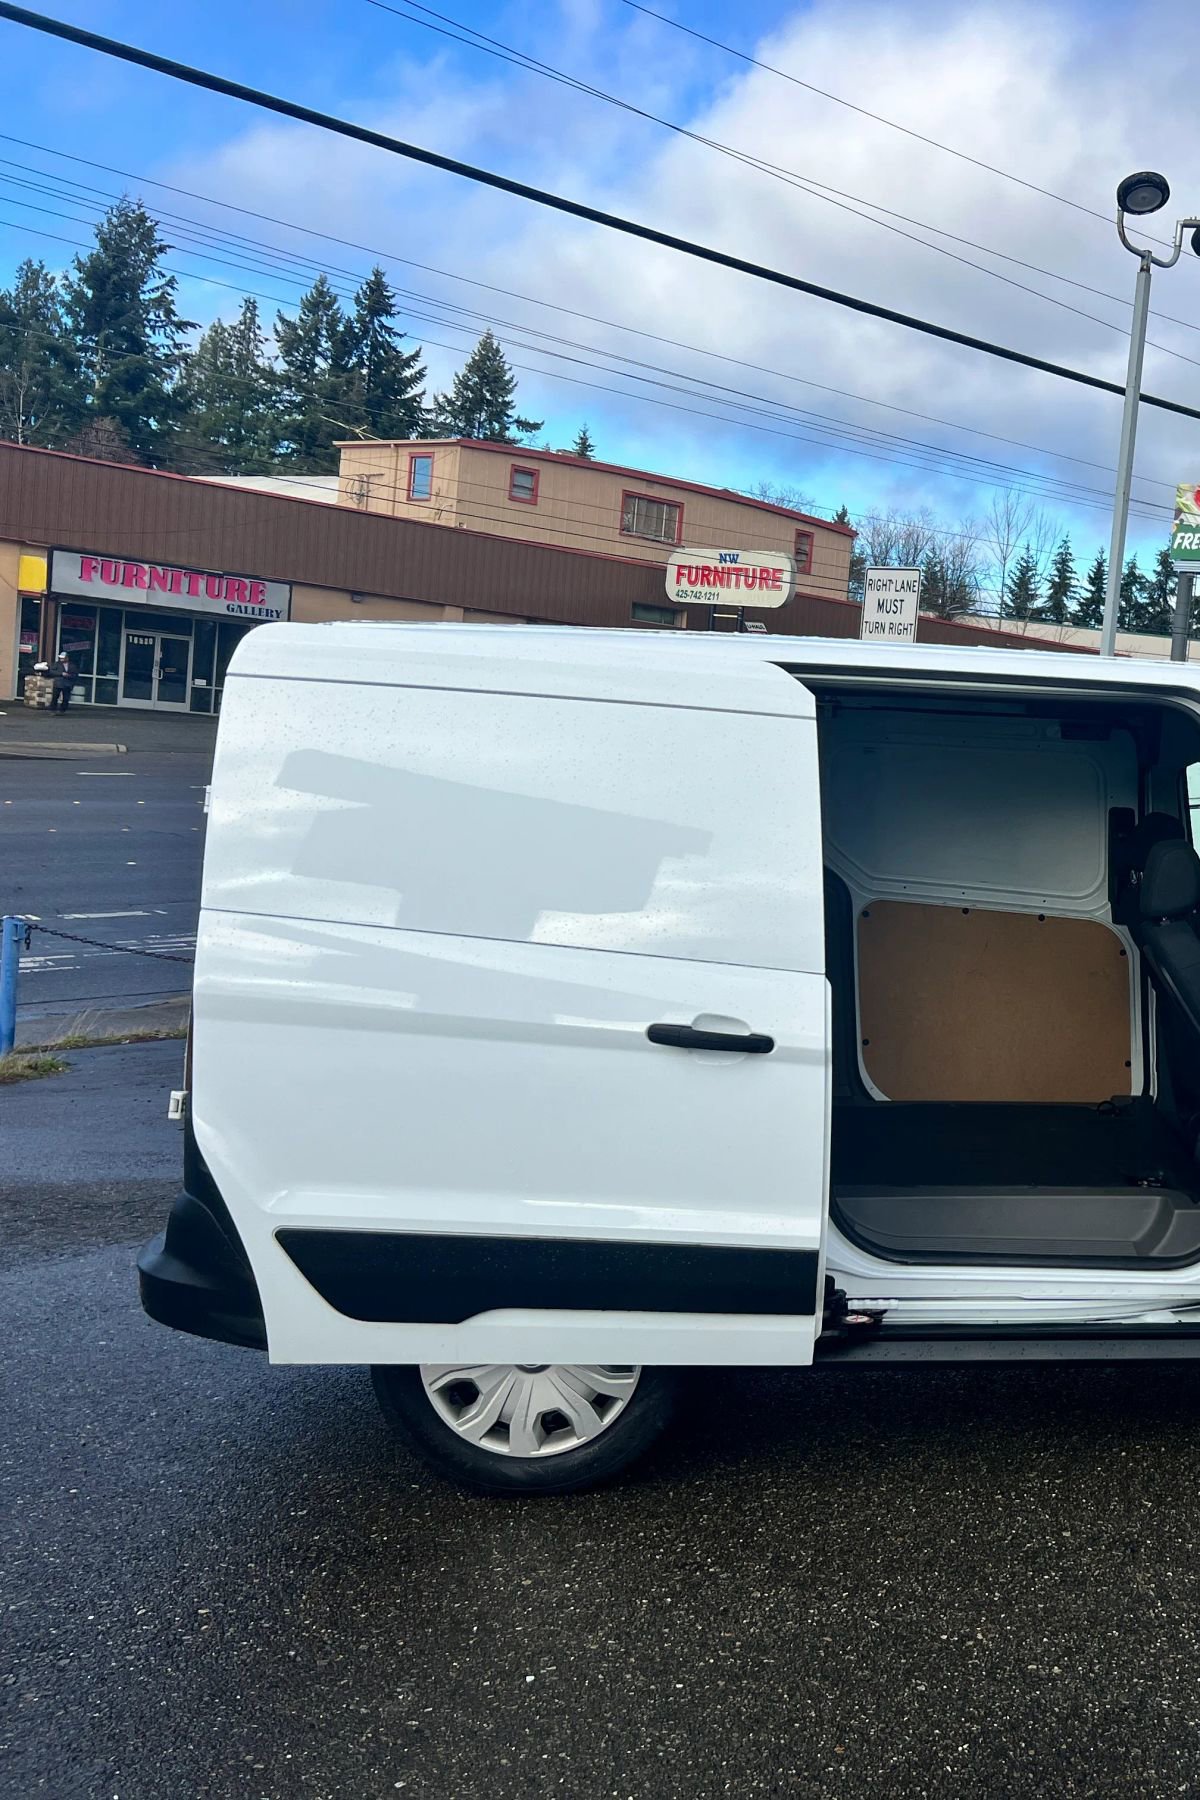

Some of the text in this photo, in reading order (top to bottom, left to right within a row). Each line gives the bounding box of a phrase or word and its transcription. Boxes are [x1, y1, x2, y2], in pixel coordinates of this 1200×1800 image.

[719, 552, 740, 564] NW
[78, 555, 268, 606] FURNITURE
[675, 565, 784, 591] FURNITURE
[867, 578, 917, 593] RIGHT LANE
[675, 589, 720, 601] 425-742-1211
[226, 603, 283, 620] GALLERY
[877, 599, 905, 615] MUST
[864, 620, 914, 636] TURN RIGHT
